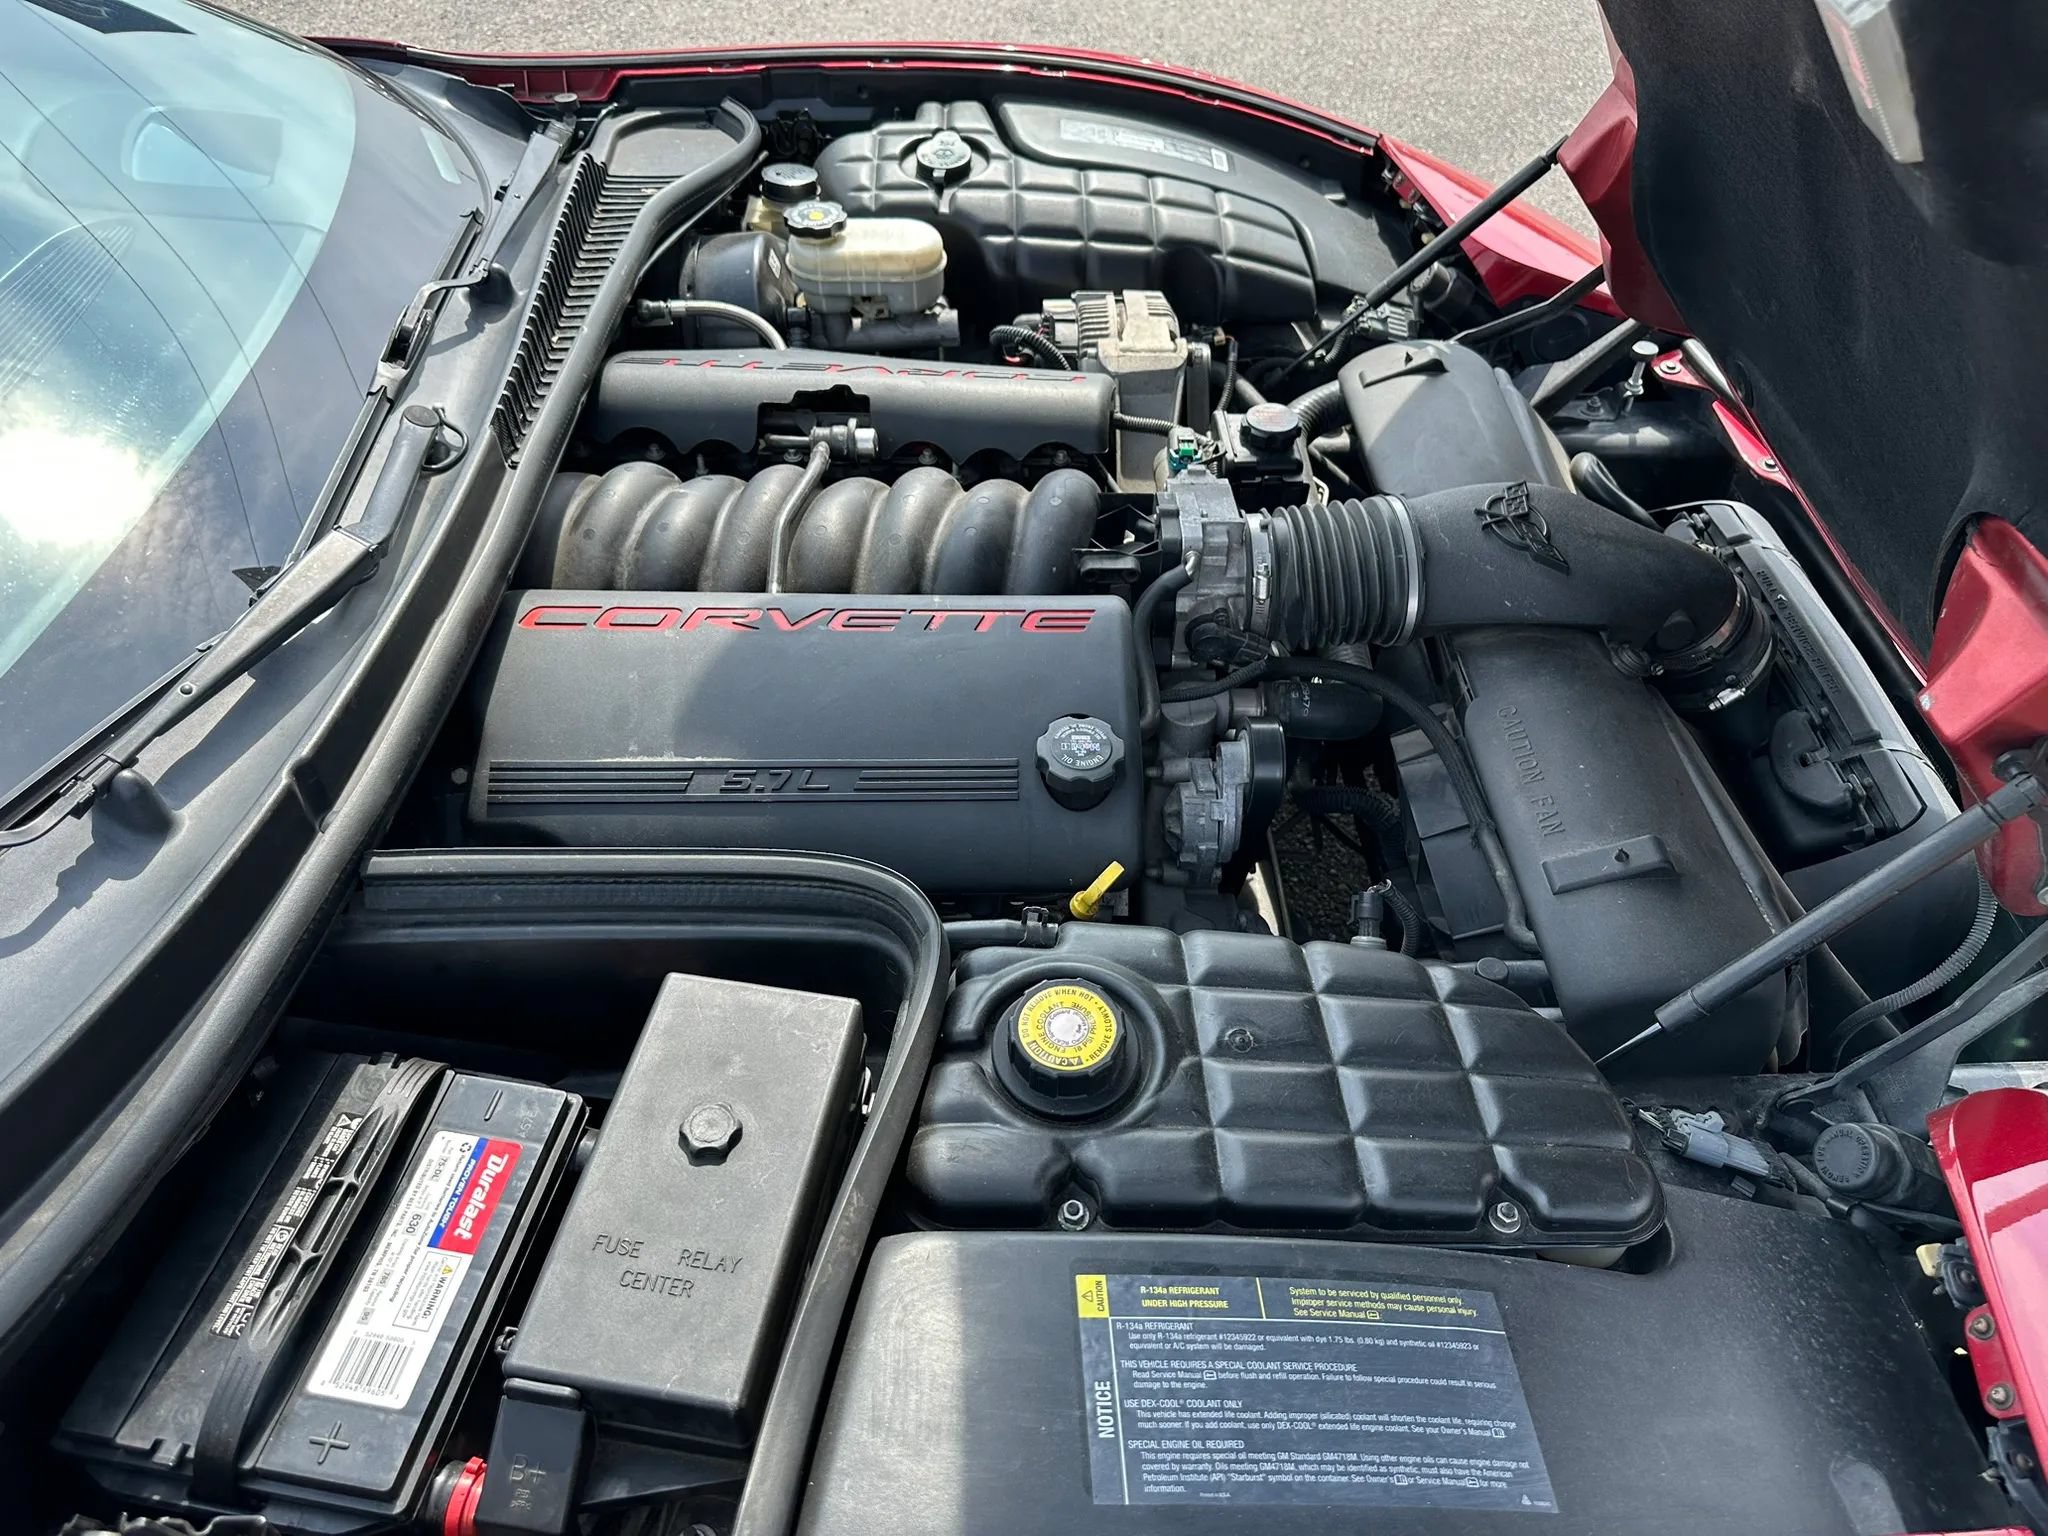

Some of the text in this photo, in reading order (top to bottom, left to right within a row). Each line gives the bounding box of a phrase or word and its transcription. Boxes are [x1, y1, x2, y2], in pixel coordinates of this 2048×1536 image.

[517, 605, 1097, 633] CORVETTE
[1061, 754, 1104, 767] ENGINE OIL
[1497, 704, 1566, 837] CAUTION FAN
[718, 769, 830, 792] 5.7L
[1079, 991, 1093, 1002] HOT
[1036, 1001, 1066, 1054] ENGINE COOLANT
[1088, 1006, 1112, 1061] REMOVE SLOWLY
[1030, 1040, 1068, 1066] CAUTION
[430, 1157, 448, 1180] 75-DL
[437, 1158, 477, 1228] PROVEN TOUGH
[450, 1150, 510, 1241] Duralast
[403, 1212, 423, 1234] 630
[416, 1218, 434, 1245] AutoZone
[592, 1234, 743, 1274] FUSE RELAY
[619, 1269, 694, 1298] CENTER
[1168, 1286, 1219, 1294] REFRIGERANT
[1289, 1287, 1317, 1297] System
[1338, 1290, 1368, 1298] serviced
[1380, 1292, 1410, 1302] qualified
[1412, 1294, 1446, 1304] personnel
[419, 1274, 448, 1320] WARNING:
[1169, 1299, 1187, 1307] HIGH
[1189, 1299, 1228, 1307] PRESSURE
[1116, 1321, 1143, 1329] R-134a
[1120, 1359, 1137, 1367] THIS
[1170, 1360, 1207, 1368] REQUIRES
[1207, 1360, 1214, 1368] A
[1214, 1360, 1245, 1368] SPECIAL
[1246, 1360, 1280, 1369] COOLANT
[1282, 1361, 1312, 1370] SERVICE
[1314, 1362, 1357, 1371] PROCEDURE
[1094, 1381, 1115, 1438] NOTICE
[1123, 1398, 1140, 1406] USE
[1186, 1399, 1220, 1407] COOLANT
[1223, 1399, 1242, 1407] ONLY
[1127, 1439, 1244, 1448] SPECIAL ENGINE OIL REQUIRED
